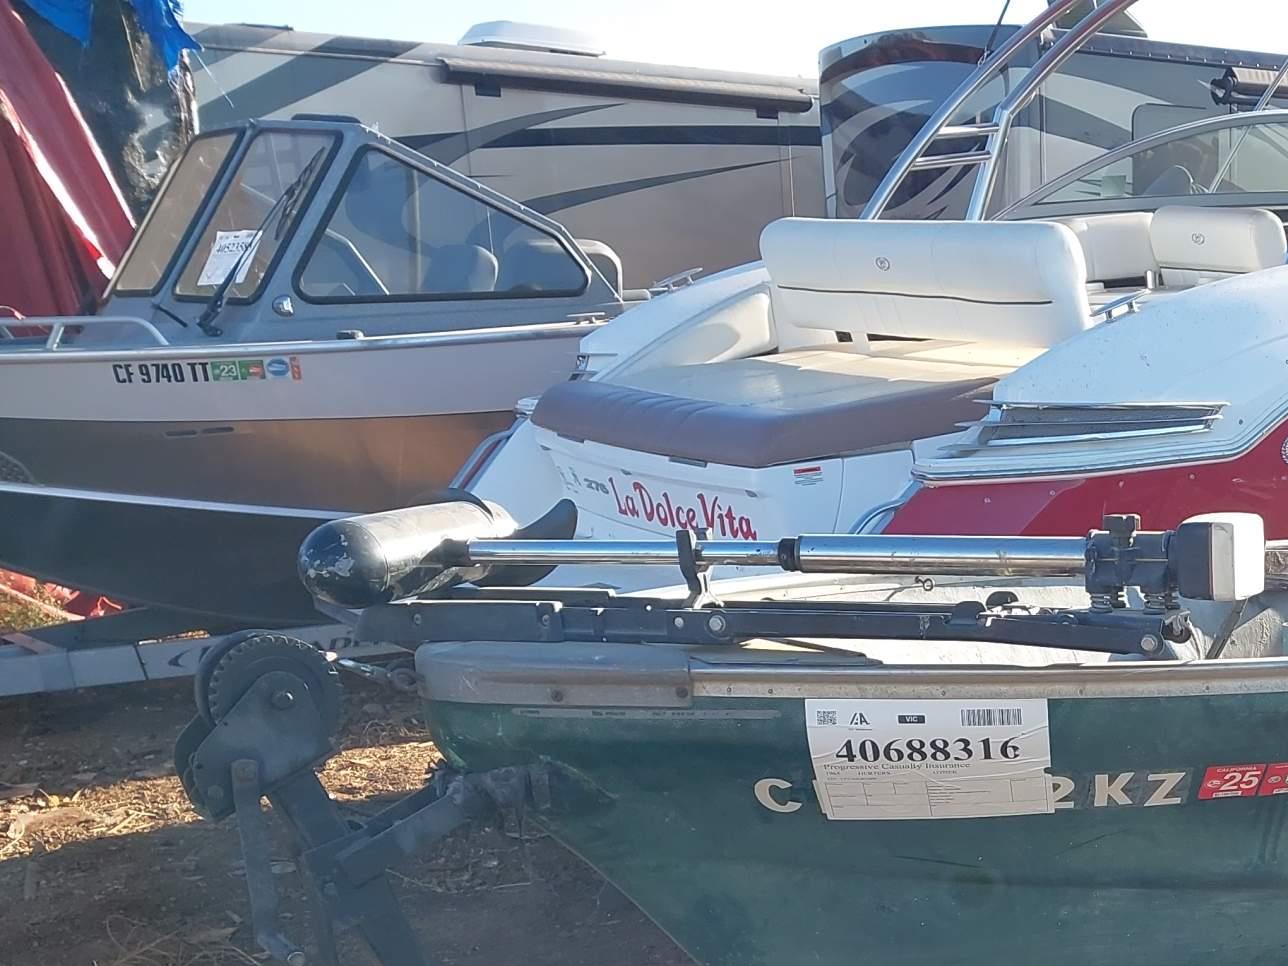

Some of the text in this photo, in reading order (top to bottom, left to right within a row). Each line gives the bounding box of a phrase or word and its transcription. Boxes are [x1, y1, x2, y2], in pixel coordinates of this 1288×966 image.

[112, 361, 210, 384] CF 9740 TT
[221, 365, 237, 377] 23
[608, 476, 640, 519] La
[633, 481, 699, 531] Dolce
[697, 492, 758, 541] Vita
[836, 736, 1020, 763] 40688316
[823, 762, 971, 772] Progressive Casualty Insurance
[1219, 770, 1261, 791] 25
